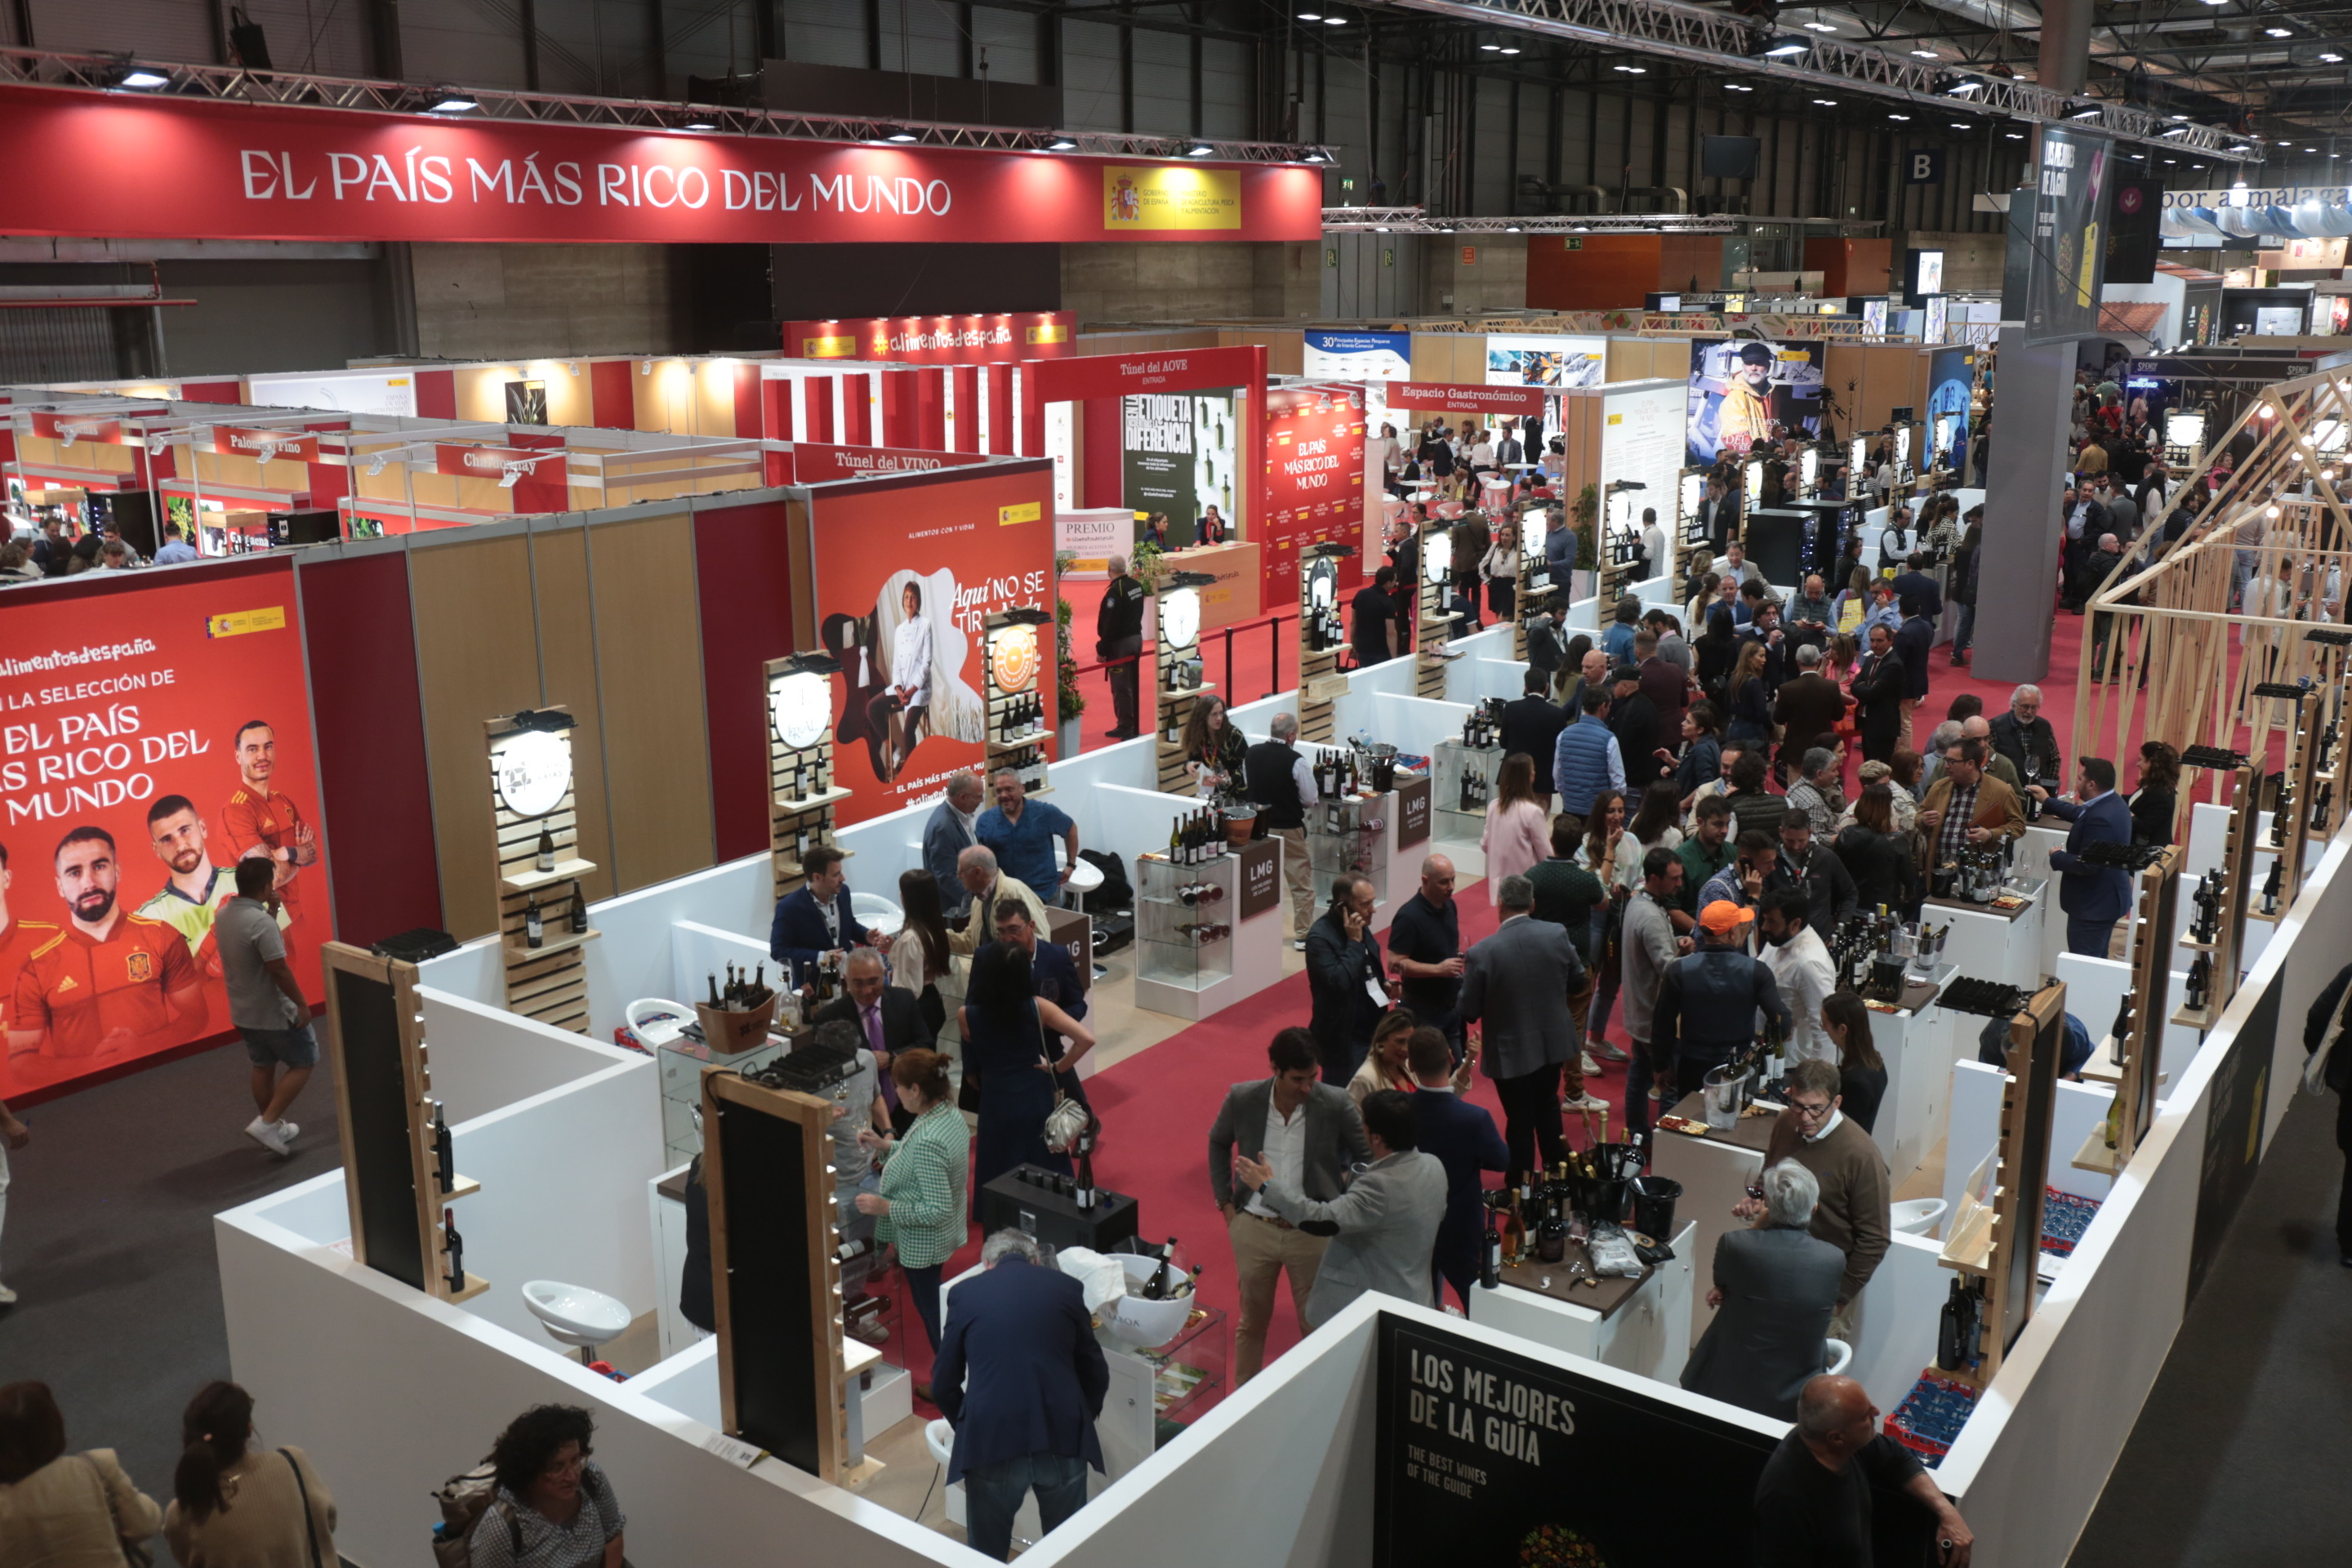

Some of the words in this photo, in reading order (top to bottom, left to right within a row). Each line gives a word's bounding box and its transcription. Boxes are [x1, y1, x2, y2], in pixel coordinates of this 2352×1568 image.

[1913, 154, 1931, 179] B
[241, 149, 318, 199] EL
[326, 145, 452, 203] PAÍS
[466, 151, 583, 205] MÁS
[598, 163, 709, 209] RICO
[719, 169, 802, 212] DEL
[810, 173, 951, 216] MUNDO
[1322, 337, 1334, 347] 30
[1120, 361, 1145, 375] Túnel
[1147, 362, 1160, 373] del
[1162, 359, 1187, 371] AOVE
[1143, 376, 1166, 385] ENTRADA
[1402, 386, 1445, 399] Espacio
[1448, 387, 1527, 402] Gastronómico
[1138, 394, 1192, 423] ETIQUETA
[1446, 402, 1477, 410] ENTRADA
[1125, 422, 1192, 454] DIFERENCIA
[1298, 442, 1309, 457] EL
[1309, 439, 1326, 454] PAÍS
[835, 452, 874, 468] Túnel
[878, 455, 898, 470] del
[1285, 459, 1303, 475] MÁS
[1303, 457, 1324, 472] RICO
[1325, 455, 1339, 469] DEL
[1296, 474, 1327, 490] MUNDO
[908, 528, 939, 539] ALIMENTOS
[1066, 522, 1115, 534] PREMIO
[948, 577, 991, 612] Aquí
[993, 576, 1019, 600] NO
[1024, 570, 1045, 594] SE
[9, 691, 35, 710] LA
[41, 673, 146, 706] SELECCIÓN
[151, 669, 175, 687] DE
[4, 723, 53, 755] EL
[58, 702, 141, 745] PAÍS
[38, 742, 131, 785] RICO
[139, 728, 210, 764] DEL
[897, 785, 906, 794] EL
[907, 777, 923, 791] PAÍS
[924, 773, 940, 786] MÁS
[6, 773, 154, 826] MUNDO
[1407, 796, 1425, 815] LMG
[1250, 859, 1273, 881] LMG
[1411, 1348, 1454, 1393] LOS
[1463, 1366, 1575, 1437] MEJORES
[1410, 1388, 1438, 1431] DE
[1448, 1402, 1475, 1444] LA
[1485, 1416, 1541, 1467] GUÍA
[1408, 1444, 1425, 1463] THE
[1429, 1452, 1454, 1473] BEST
[1456, 1463, 1487, 1486] WINES
[1407, 1463, 1421, 1479] OF
[1423, 1468, 1440, 1486] THE
[1443, 1477, 1472, 1499] GUIDE
